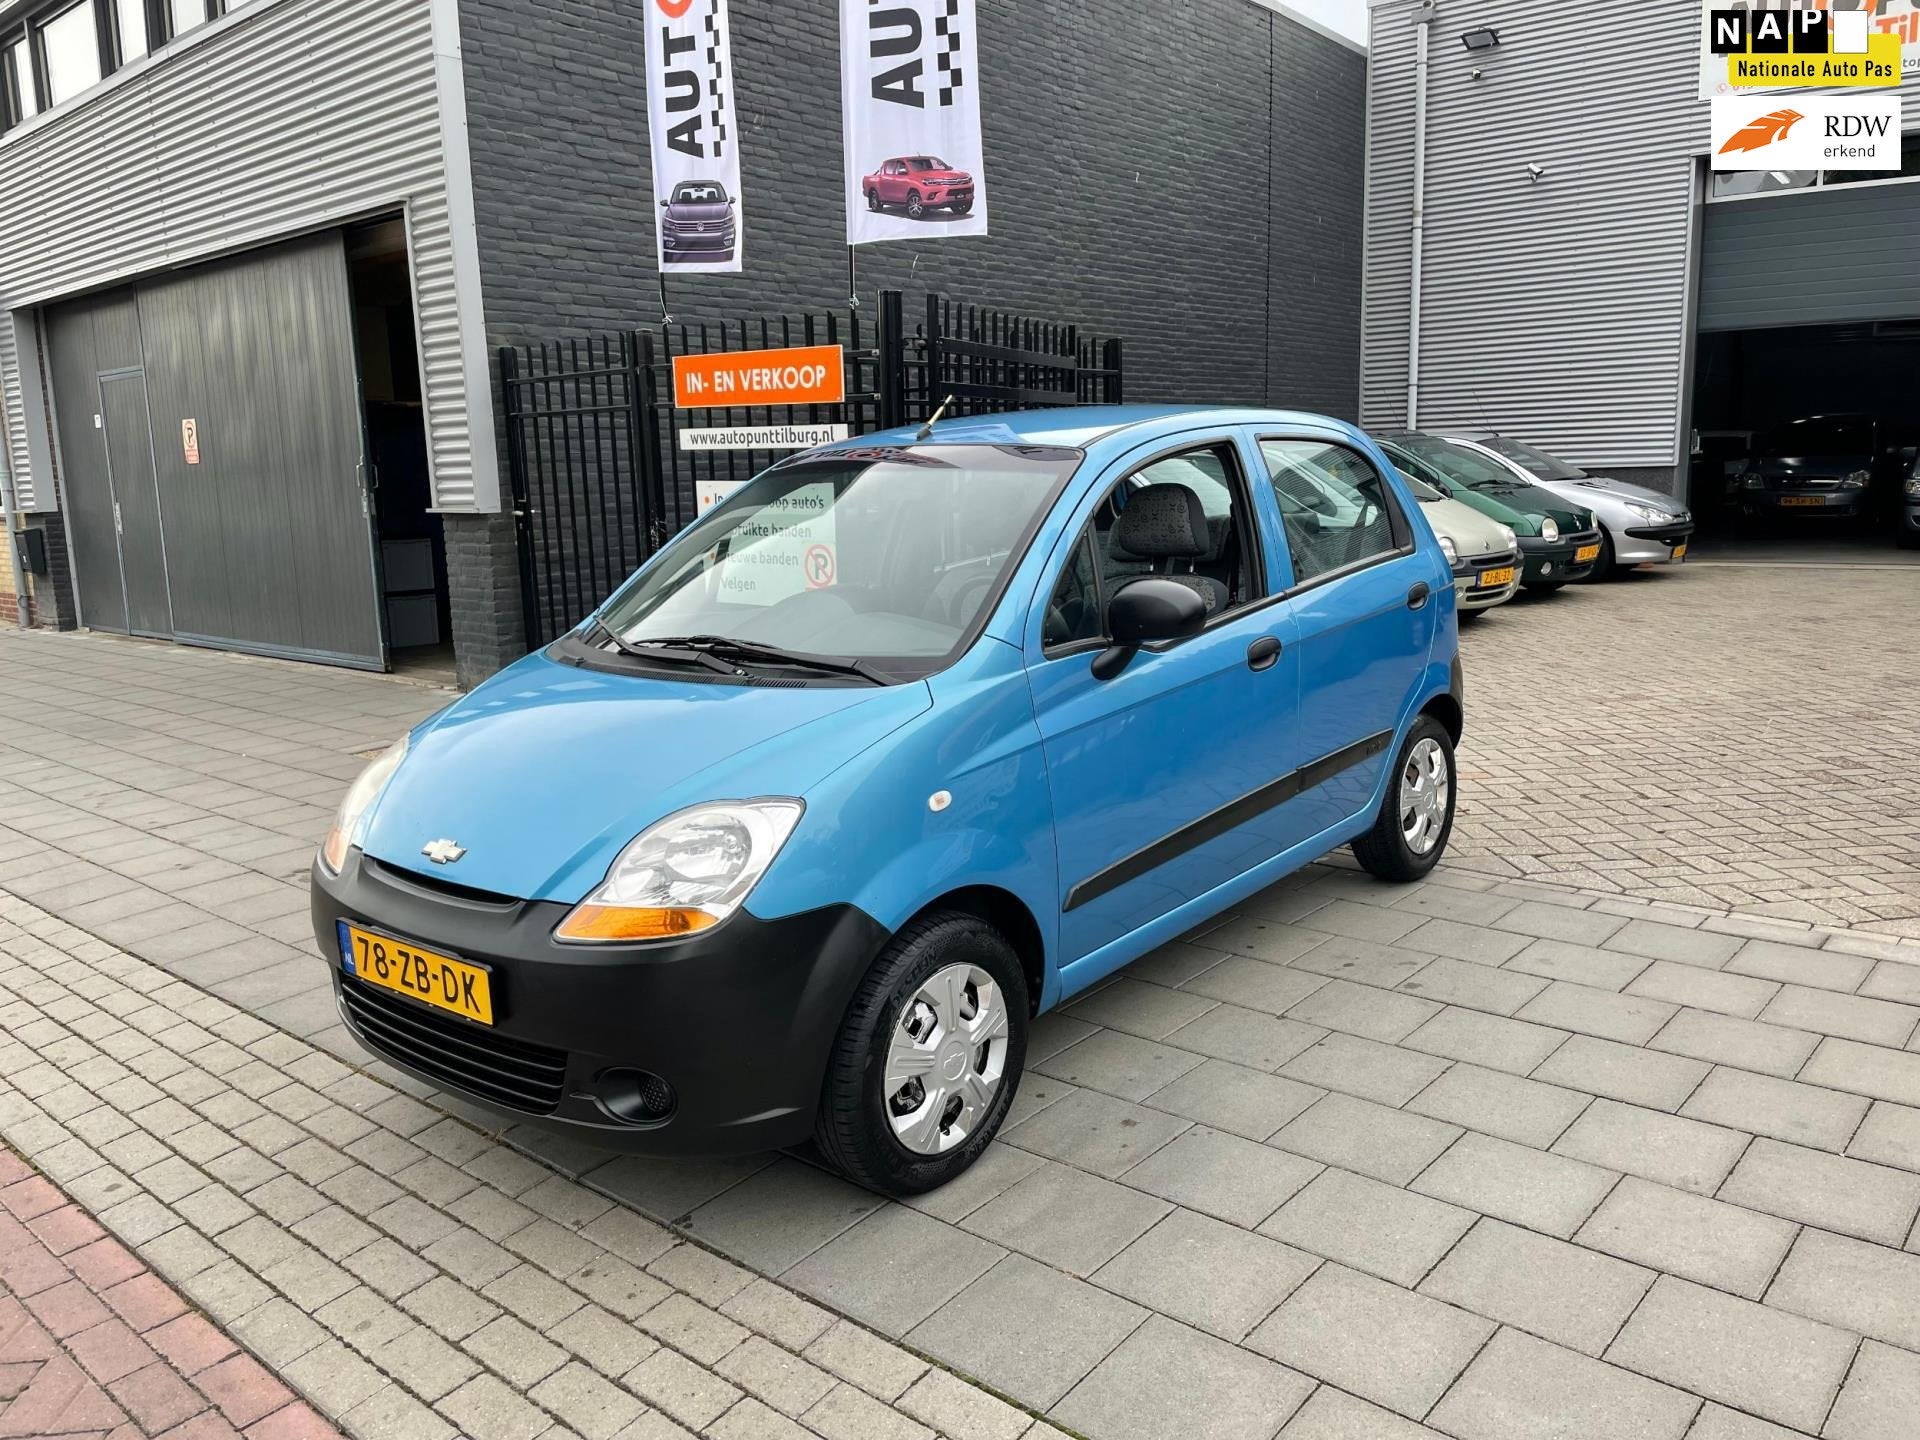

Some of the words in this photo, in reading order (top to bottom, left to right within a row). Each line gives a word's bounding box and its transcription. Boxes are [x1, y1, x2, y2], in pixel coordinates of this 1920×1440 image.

[868, 0, 925, 109] AU
[686, 372, 709, 393] IN-
[714, 370, 735, 392] EN
[739, 365, 826, 391] VERKOOP
[690, 426, 835, 447] www.autopunttilburg.nl
[792, 495, 825, 509] auto's
[771, 522, 812, 538] banden
[759, 550, 799, 566] banden
[721, 576, 756, 592] Velgen
[357, 936, 481, 1013] 78-ZB-DK
